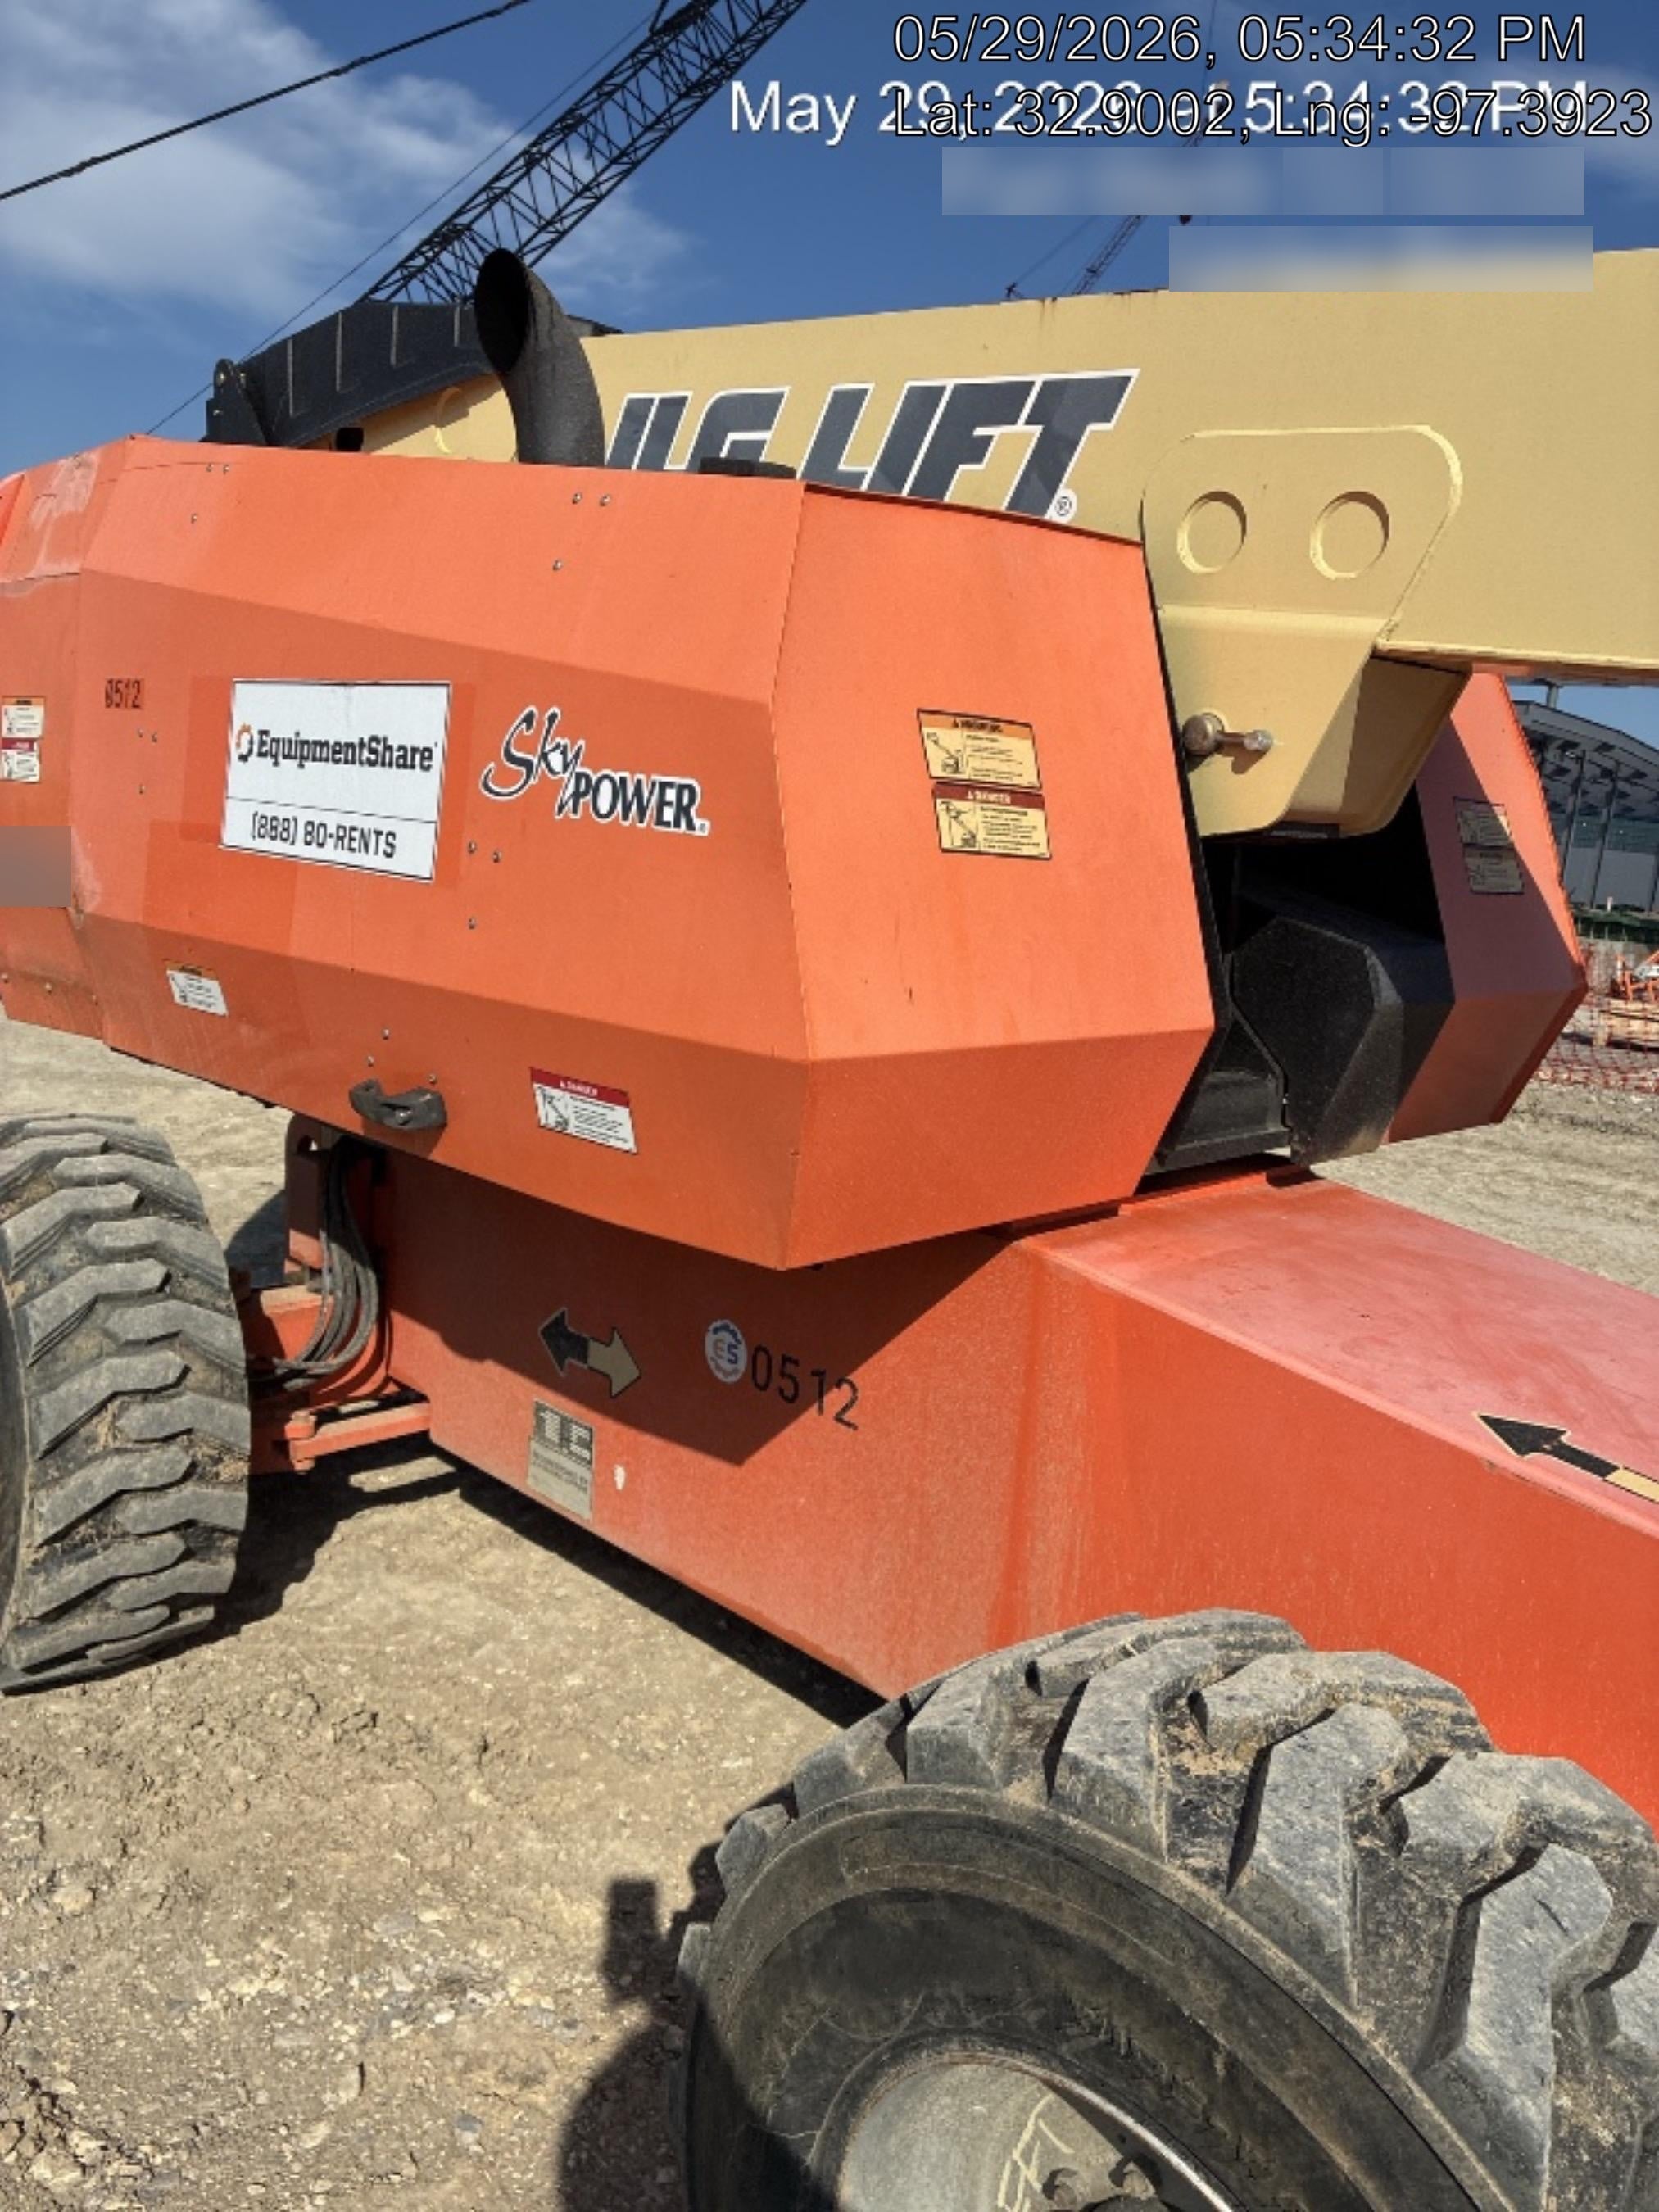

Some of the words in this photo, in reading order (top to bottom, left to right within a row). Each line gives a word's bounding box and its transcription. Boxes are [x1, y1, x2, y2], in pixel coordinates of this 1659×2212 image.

[256, 728, 434, 772] EquipmentShare
[480, 705, 585, 818] Sky
[572, 770, 701, 832] POWER
[251, 811, 298, 846] (888)
[303, 820, 397, 859] 80-RENTS
[751, 1344, 859, 1431] 0512
